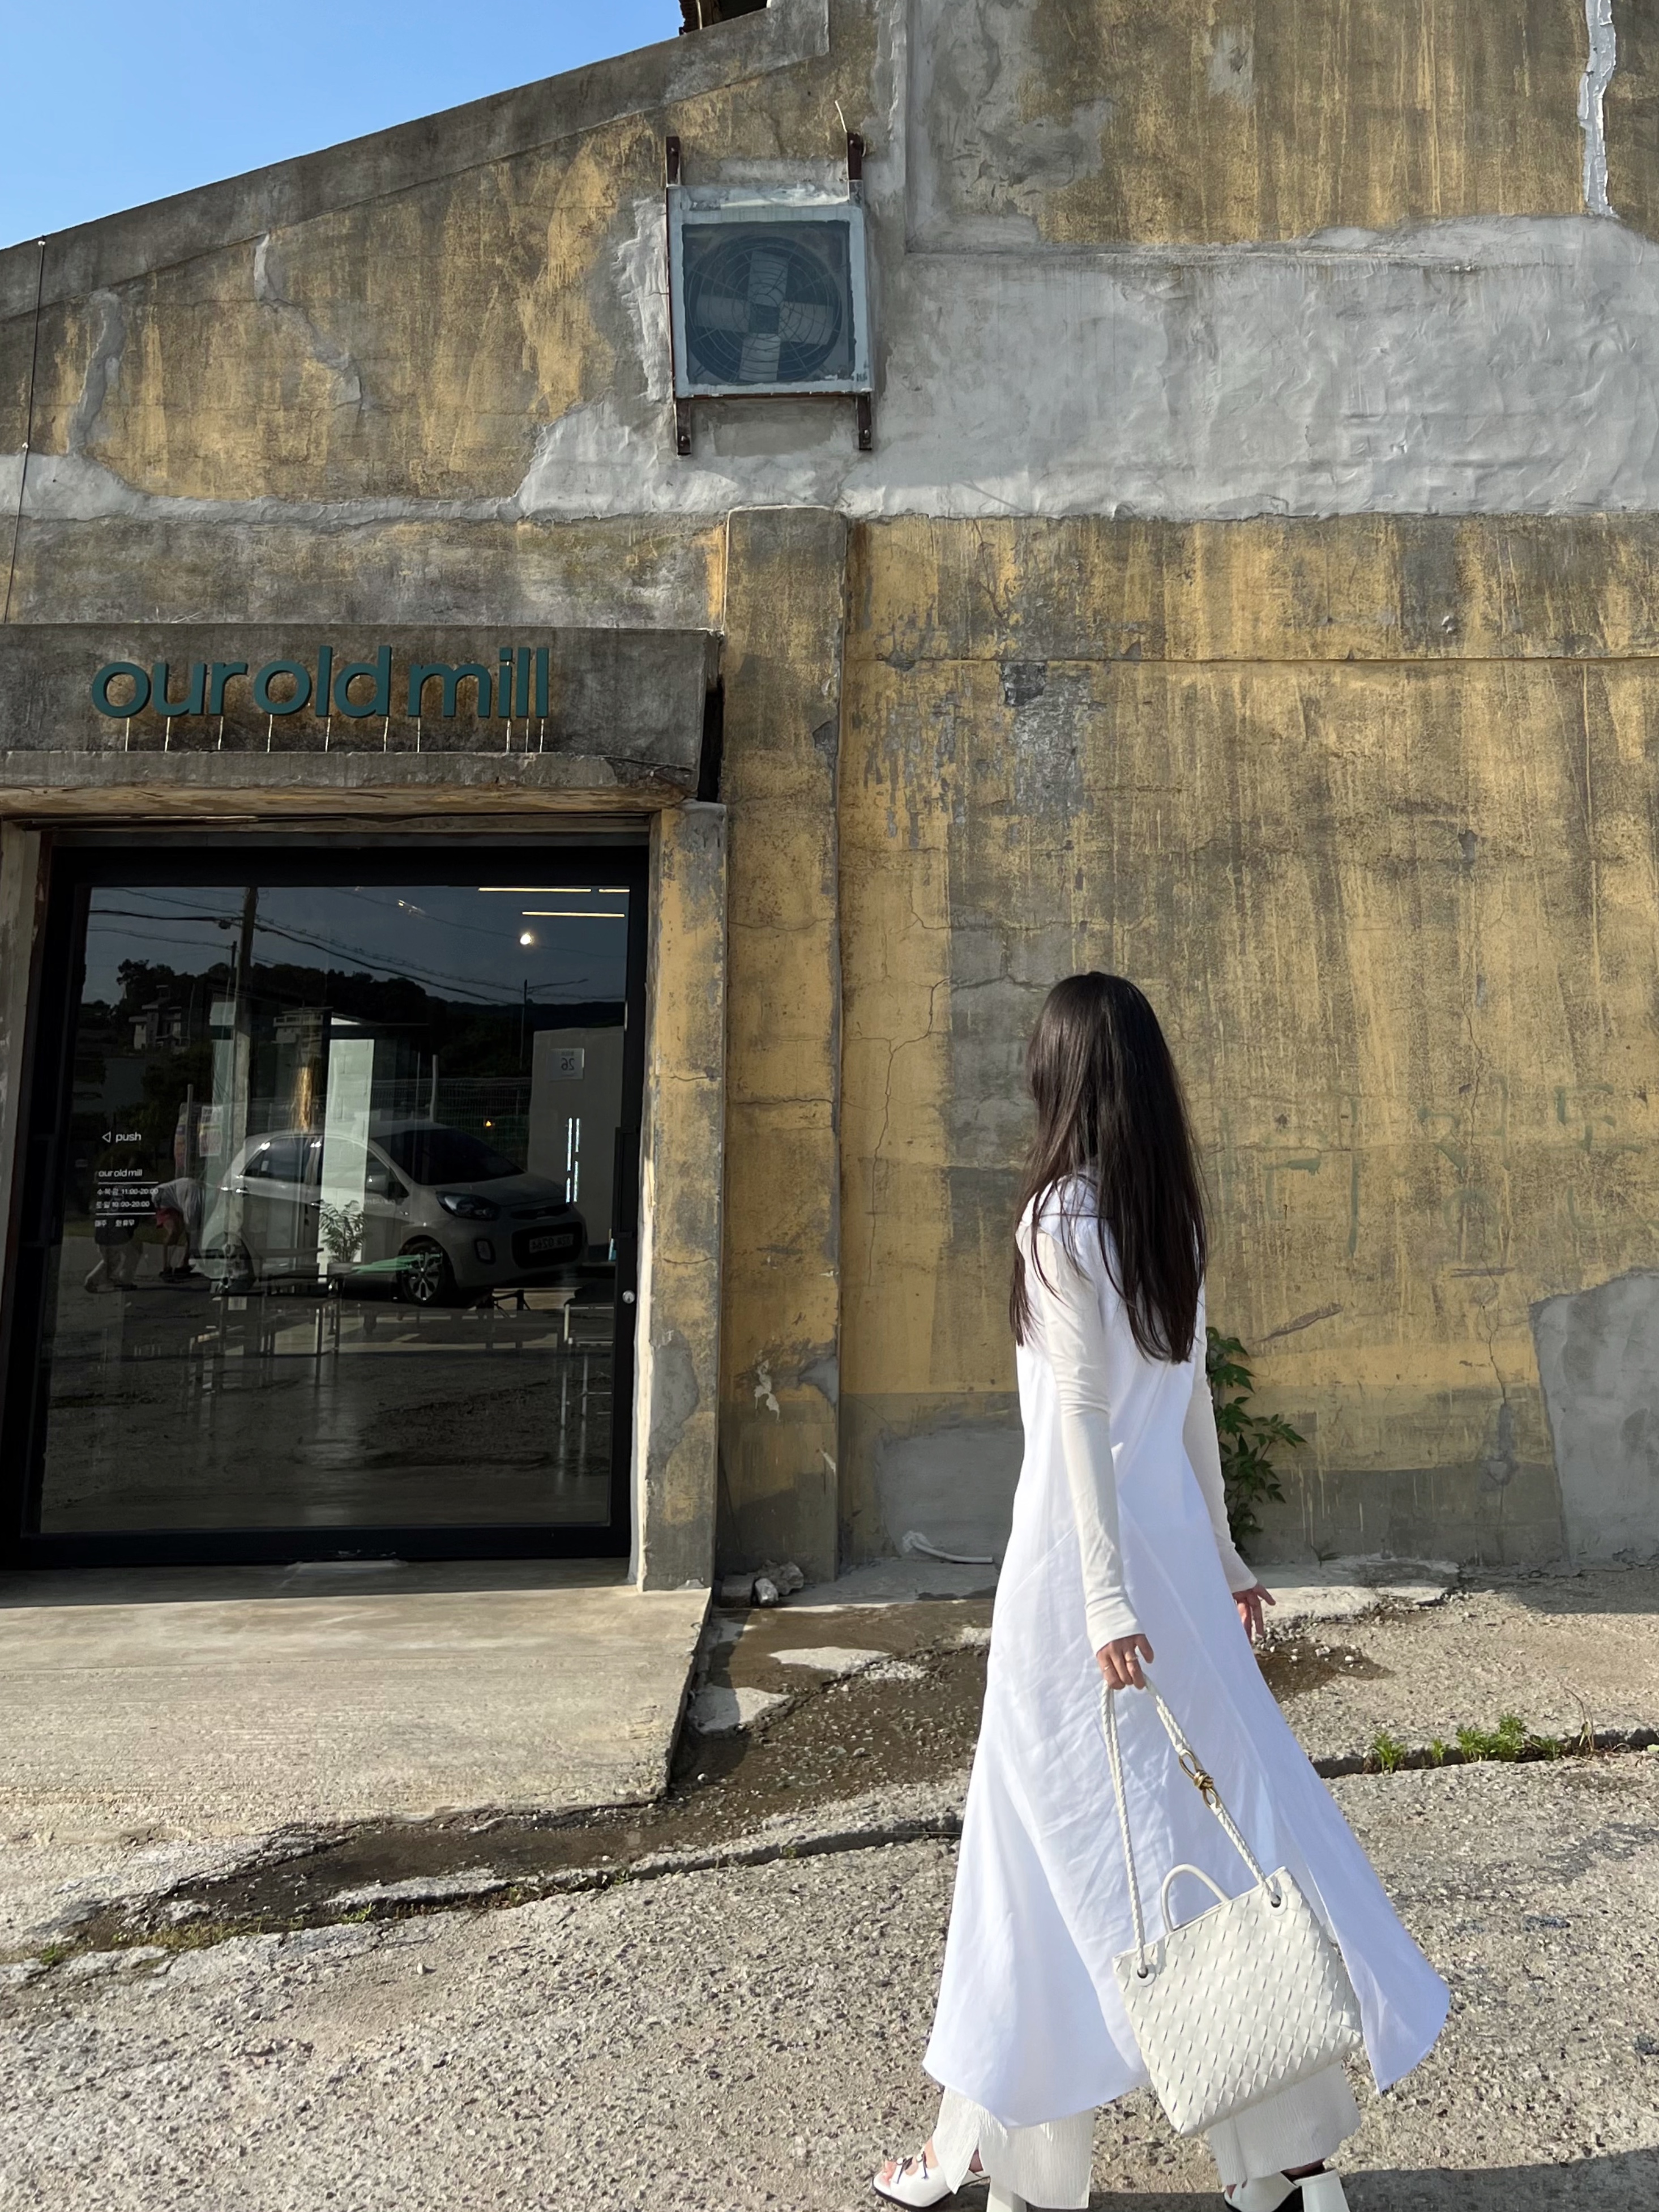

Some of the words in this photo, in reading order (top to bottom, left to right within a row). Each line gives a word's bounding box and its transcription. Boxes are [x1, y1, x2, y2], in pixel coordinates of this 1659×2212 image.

[92, 661, 248, 718] our
[253, 644, 392, 718] old
[407, 647, 550, 718] mill
[116, 1131, 142, 1143] push
[114, 1168, 127, 1177] old
[128, 1168, 143, 1177] mill
